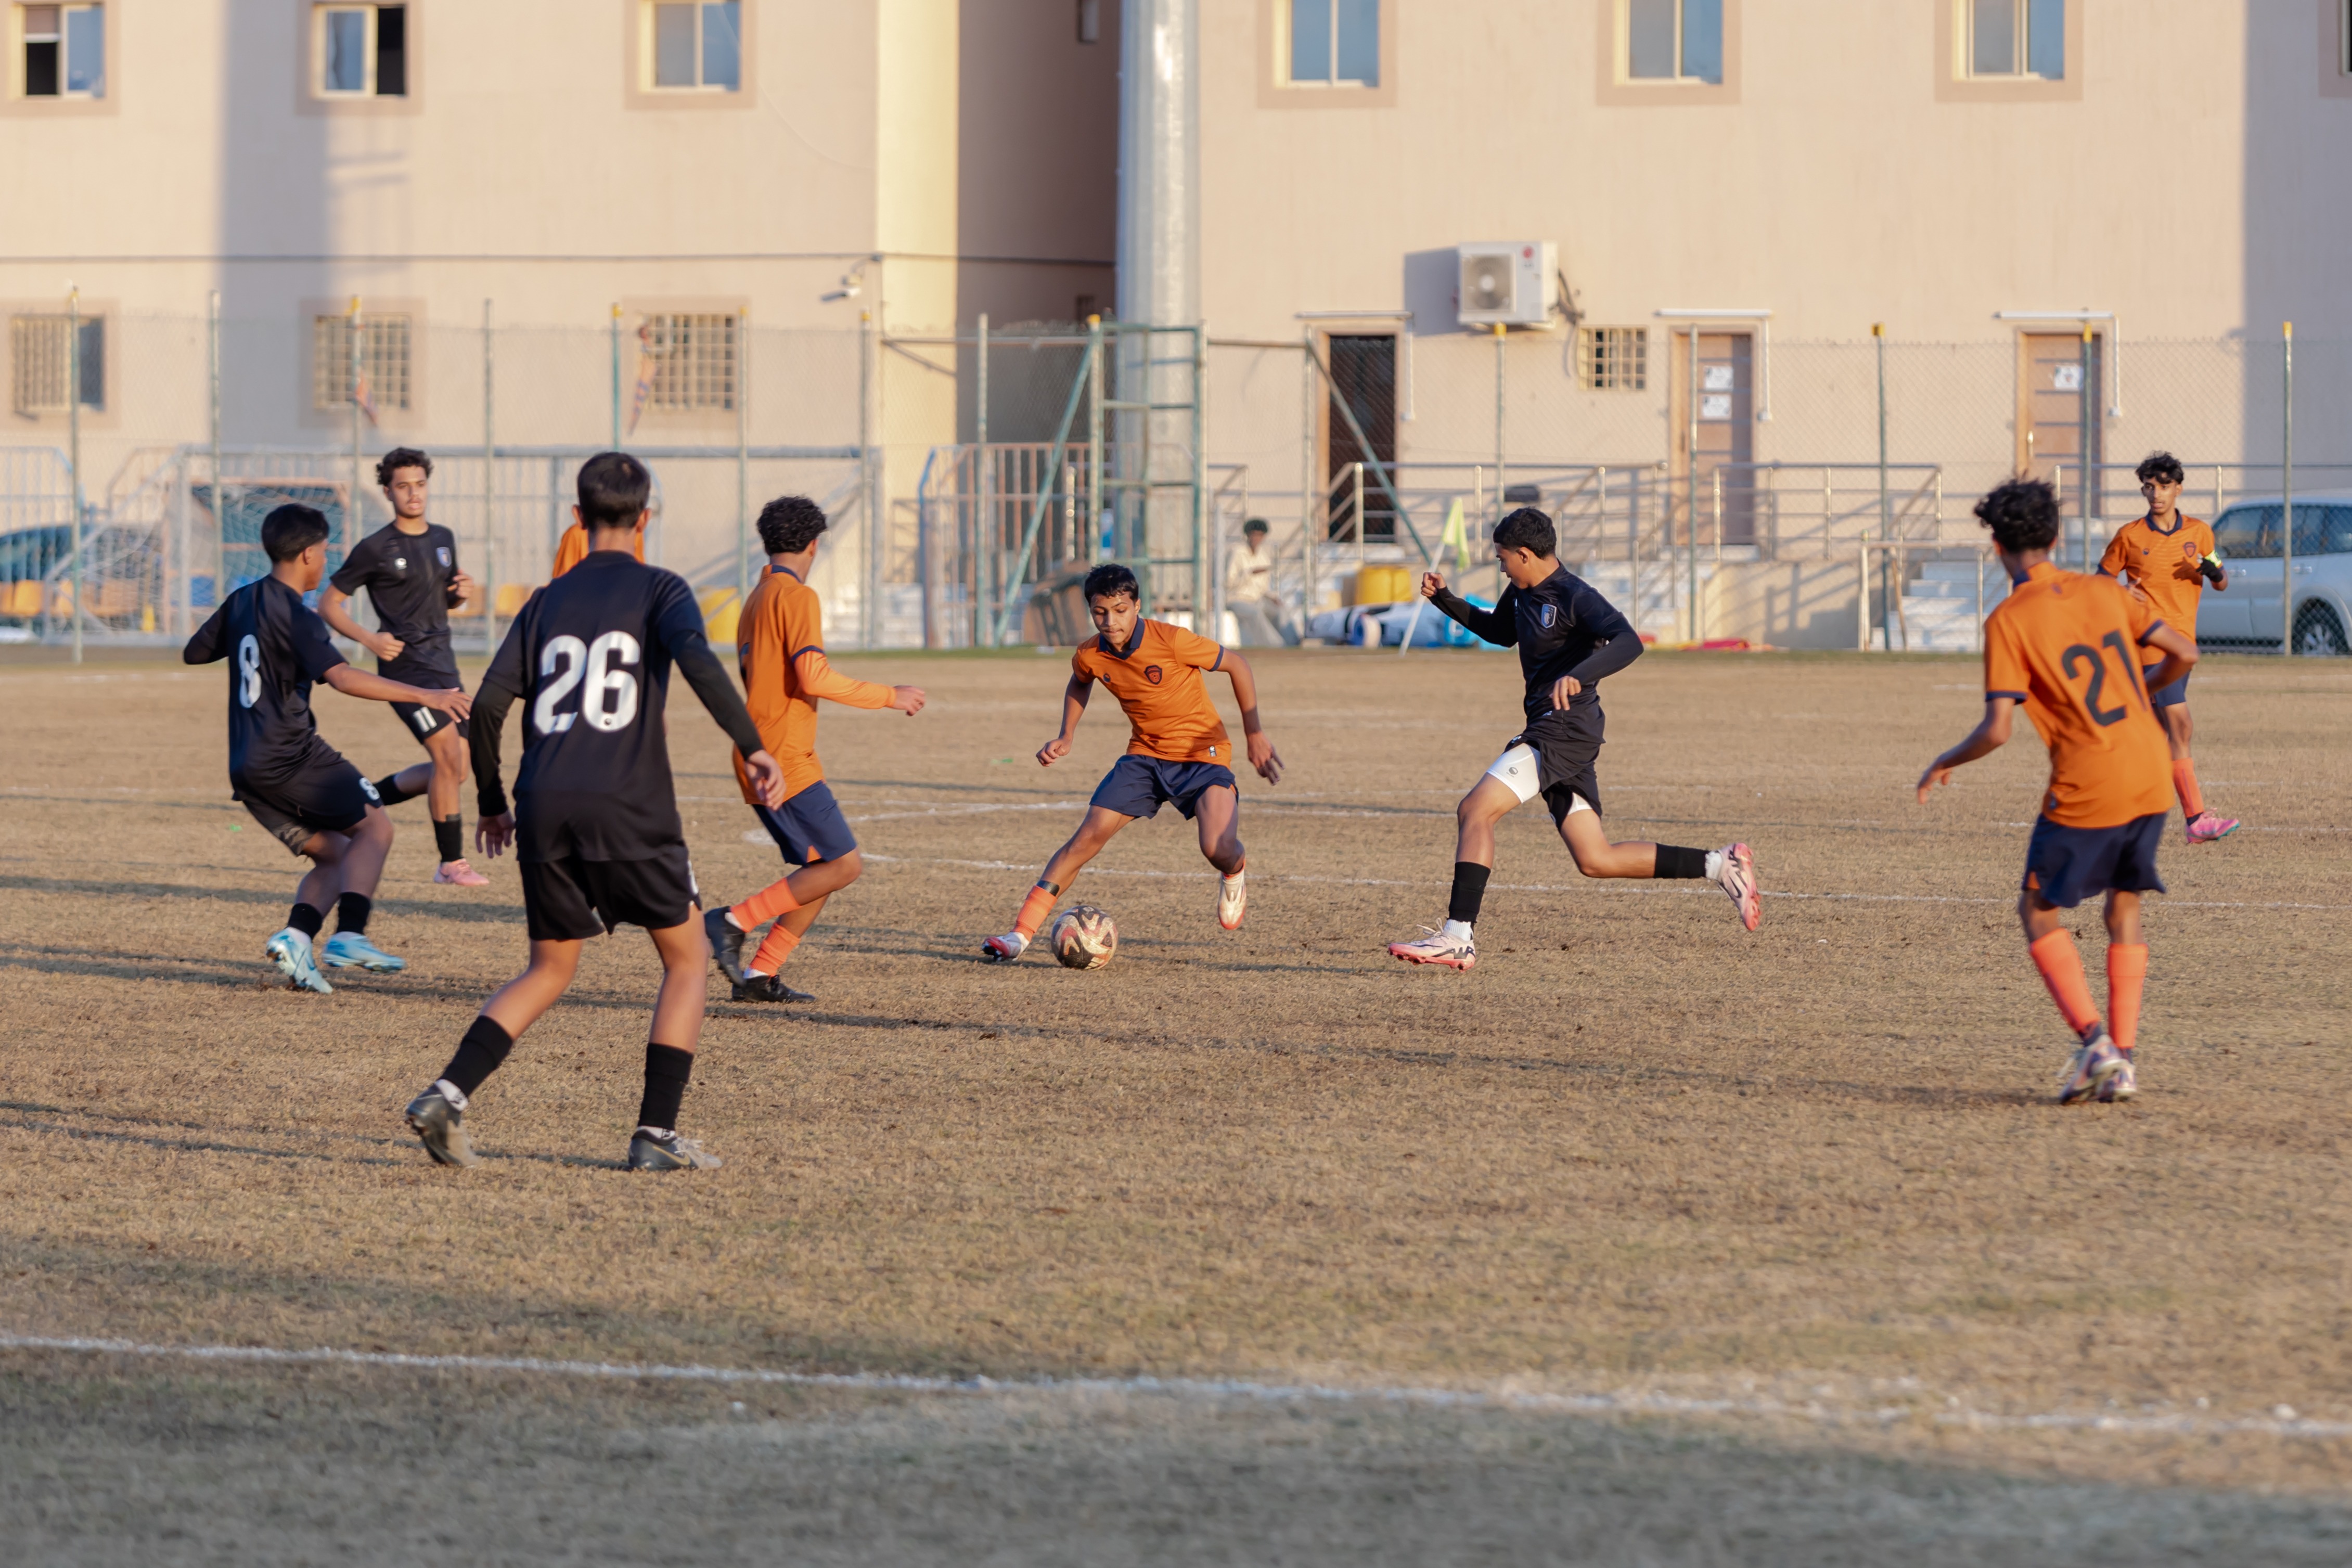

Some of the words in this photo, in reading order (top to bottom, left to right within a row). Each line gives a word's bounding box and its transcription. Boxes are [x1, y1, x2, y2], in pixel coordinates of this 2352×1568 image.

[238, 634, 262, 708] 8
[534, 631, 640, 735] 26
[2061, 629, 2148, 727] 21
[413, 706, 437, 732] 11
